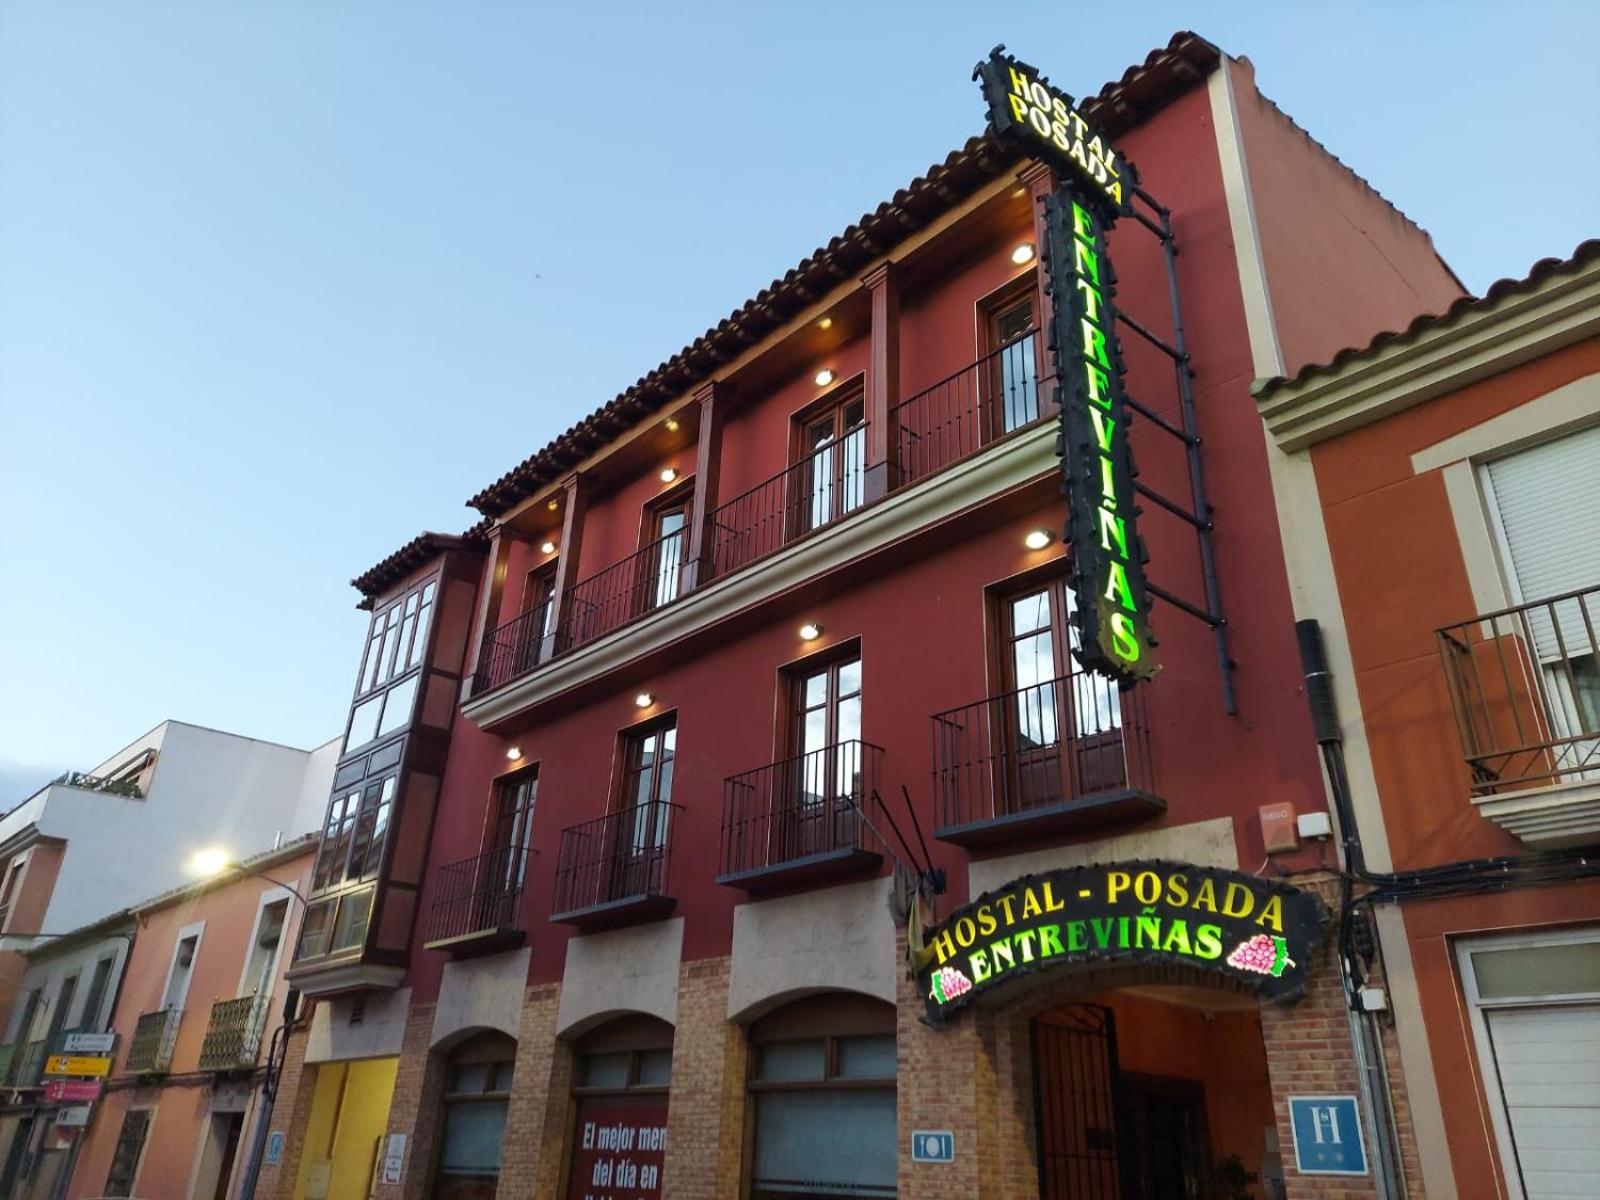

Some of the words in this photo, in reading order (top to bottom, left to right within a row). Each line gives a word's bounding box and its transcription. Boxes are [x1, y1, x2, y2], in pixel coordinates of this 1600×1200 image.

[1008, 93, 1121, 205] POSADA
[1009, 66, 1120, 178] HOSTAL
[1072, 201, 1141, 663] ENTREVIÑAS
[933, 882, 1064, 964] HOSTAL
[1107, 871, 1284, 933] POSADA
[968, 907, 1224, 985] ENTREVIÑAS
[583, 1122, 596, 1149] El
[597, 1121, 635, 1152] mejor
[592, 1158, 614, 1187] del
[616, 1158, 637, 1188] día
[640, 1164, 658, 1190] en
